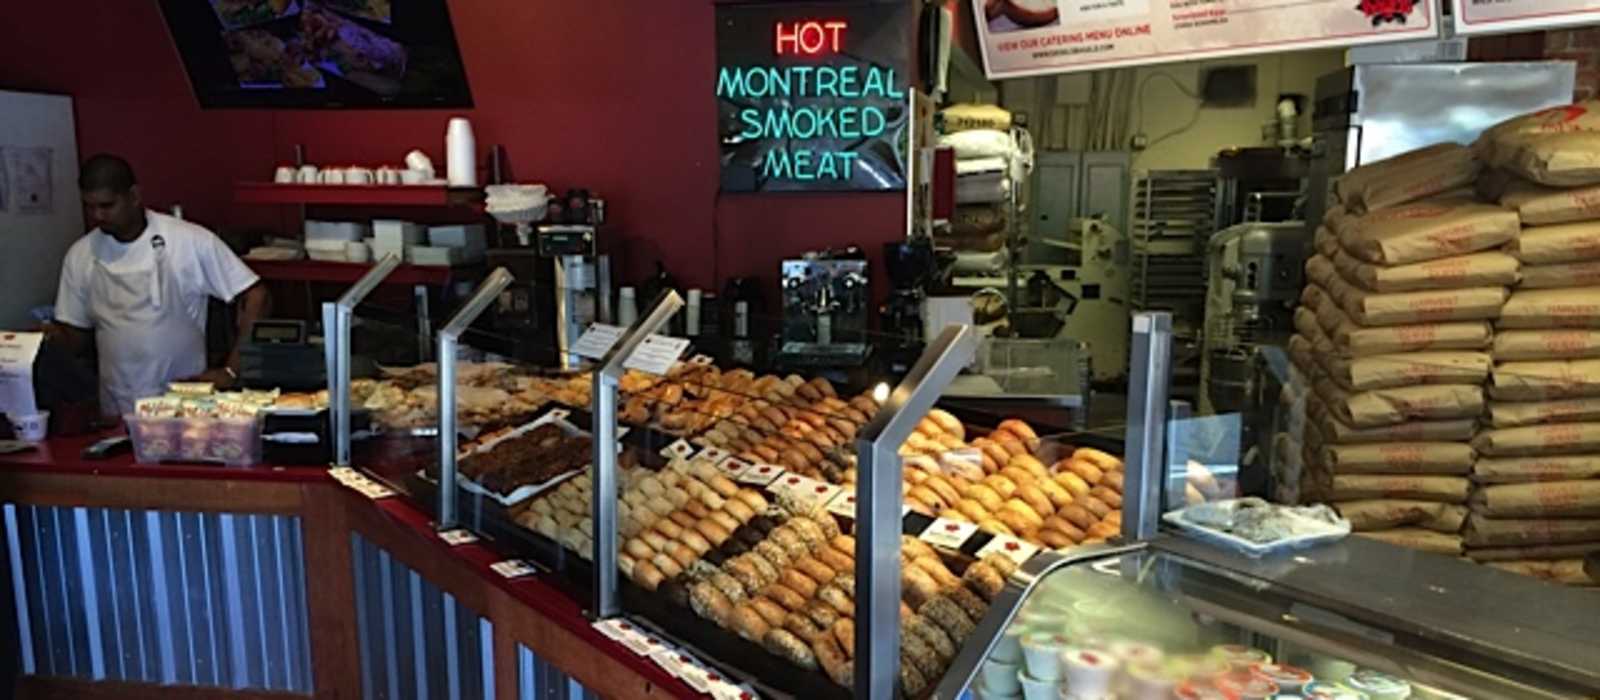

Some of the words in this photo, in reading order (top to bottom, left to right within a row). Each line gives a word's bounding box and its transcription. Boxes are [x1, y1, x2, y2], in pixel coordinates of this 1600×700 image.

[776, 22, 847, 53] HOT
[1020, 38, 1038, 49] OUR
[1040, 32, 1083, 48] CATERING
[1085, 29, 1113, 42] MENU
[1115, 24, 1151, 38] ONLINE
[716, 65, 904, 98] MONTREAL
[741, 106, 887, 139] SMOKED
[763, 149, 859, 181] MEAT
